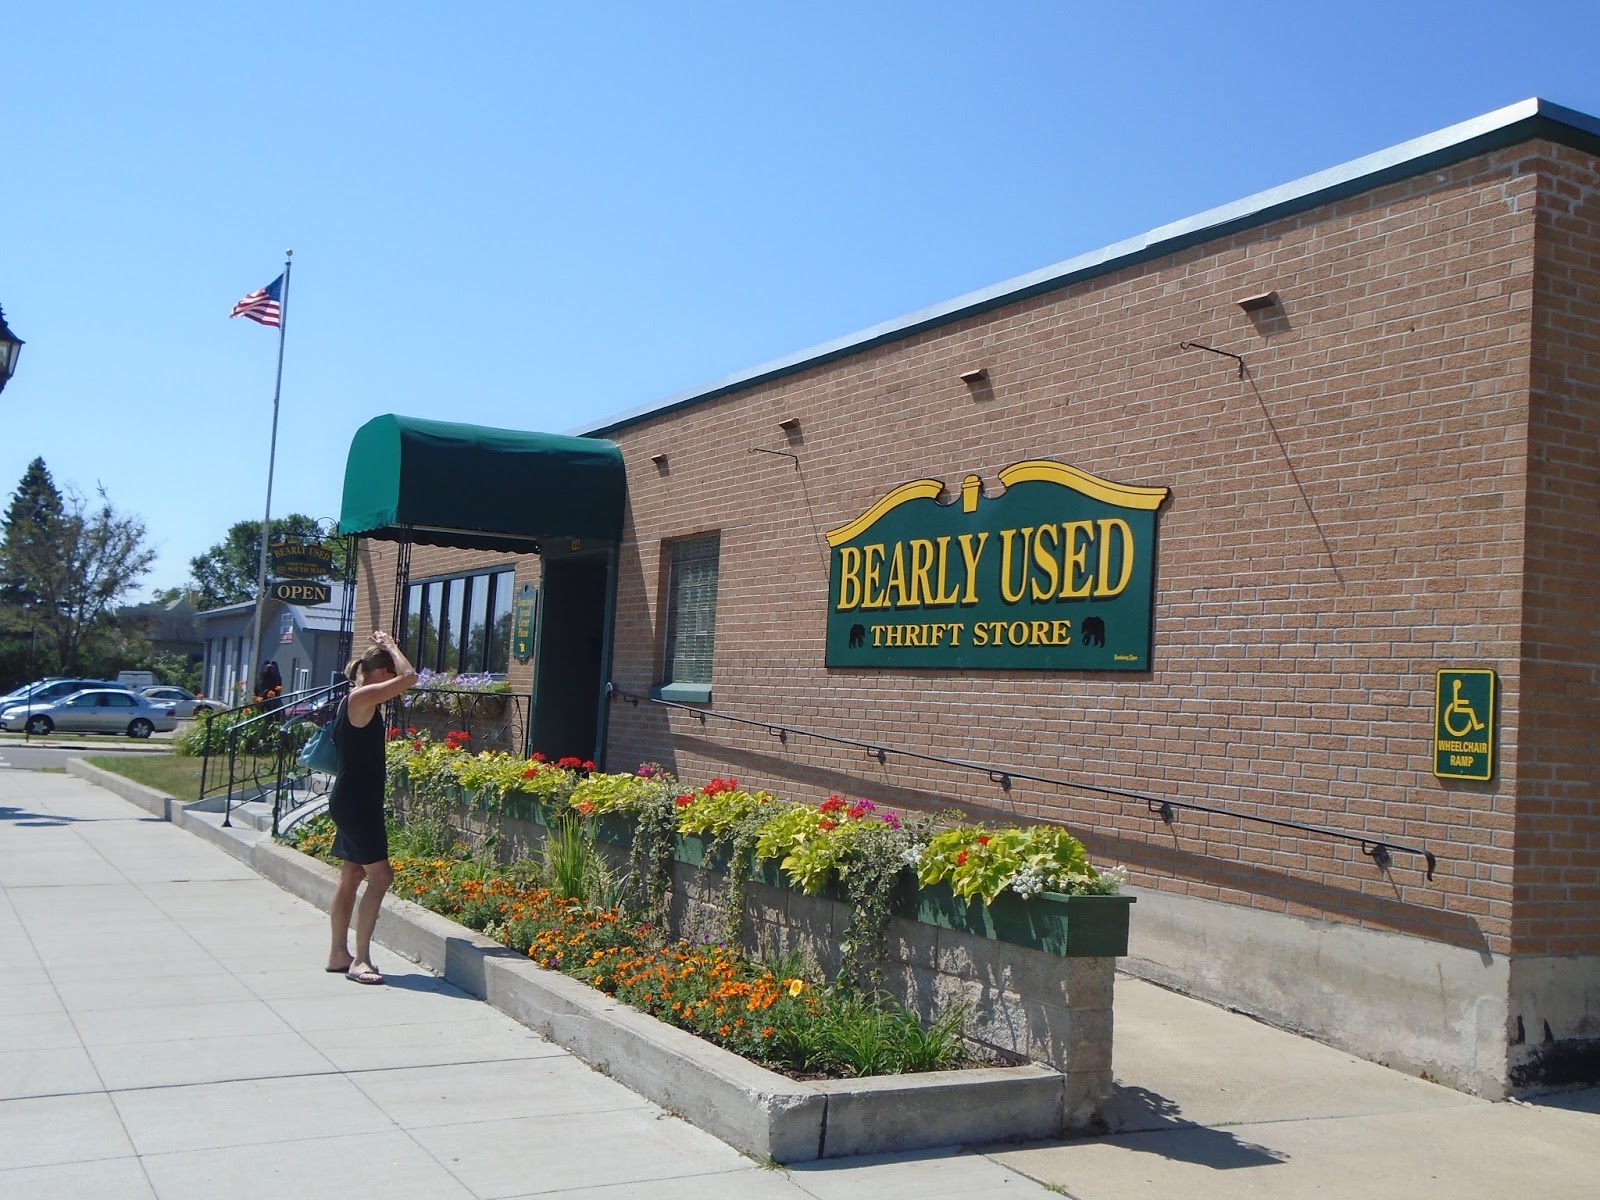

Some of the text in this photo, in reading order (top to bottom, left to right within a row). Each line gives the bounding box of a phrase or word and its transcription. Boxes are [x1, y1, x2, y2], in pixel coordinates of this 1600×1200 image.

[274, 546, 330, 561] BEARLY USED
[837, 518, 1135, 610] BEARLY USED
[277, 585, 327, 600] OPEN
[870, 620, 1071, 646] THRIFT STORE
[1438, 740, 1488, 754] WHEELCHAIR
[1450, 755, 1474, 767] RAMP
